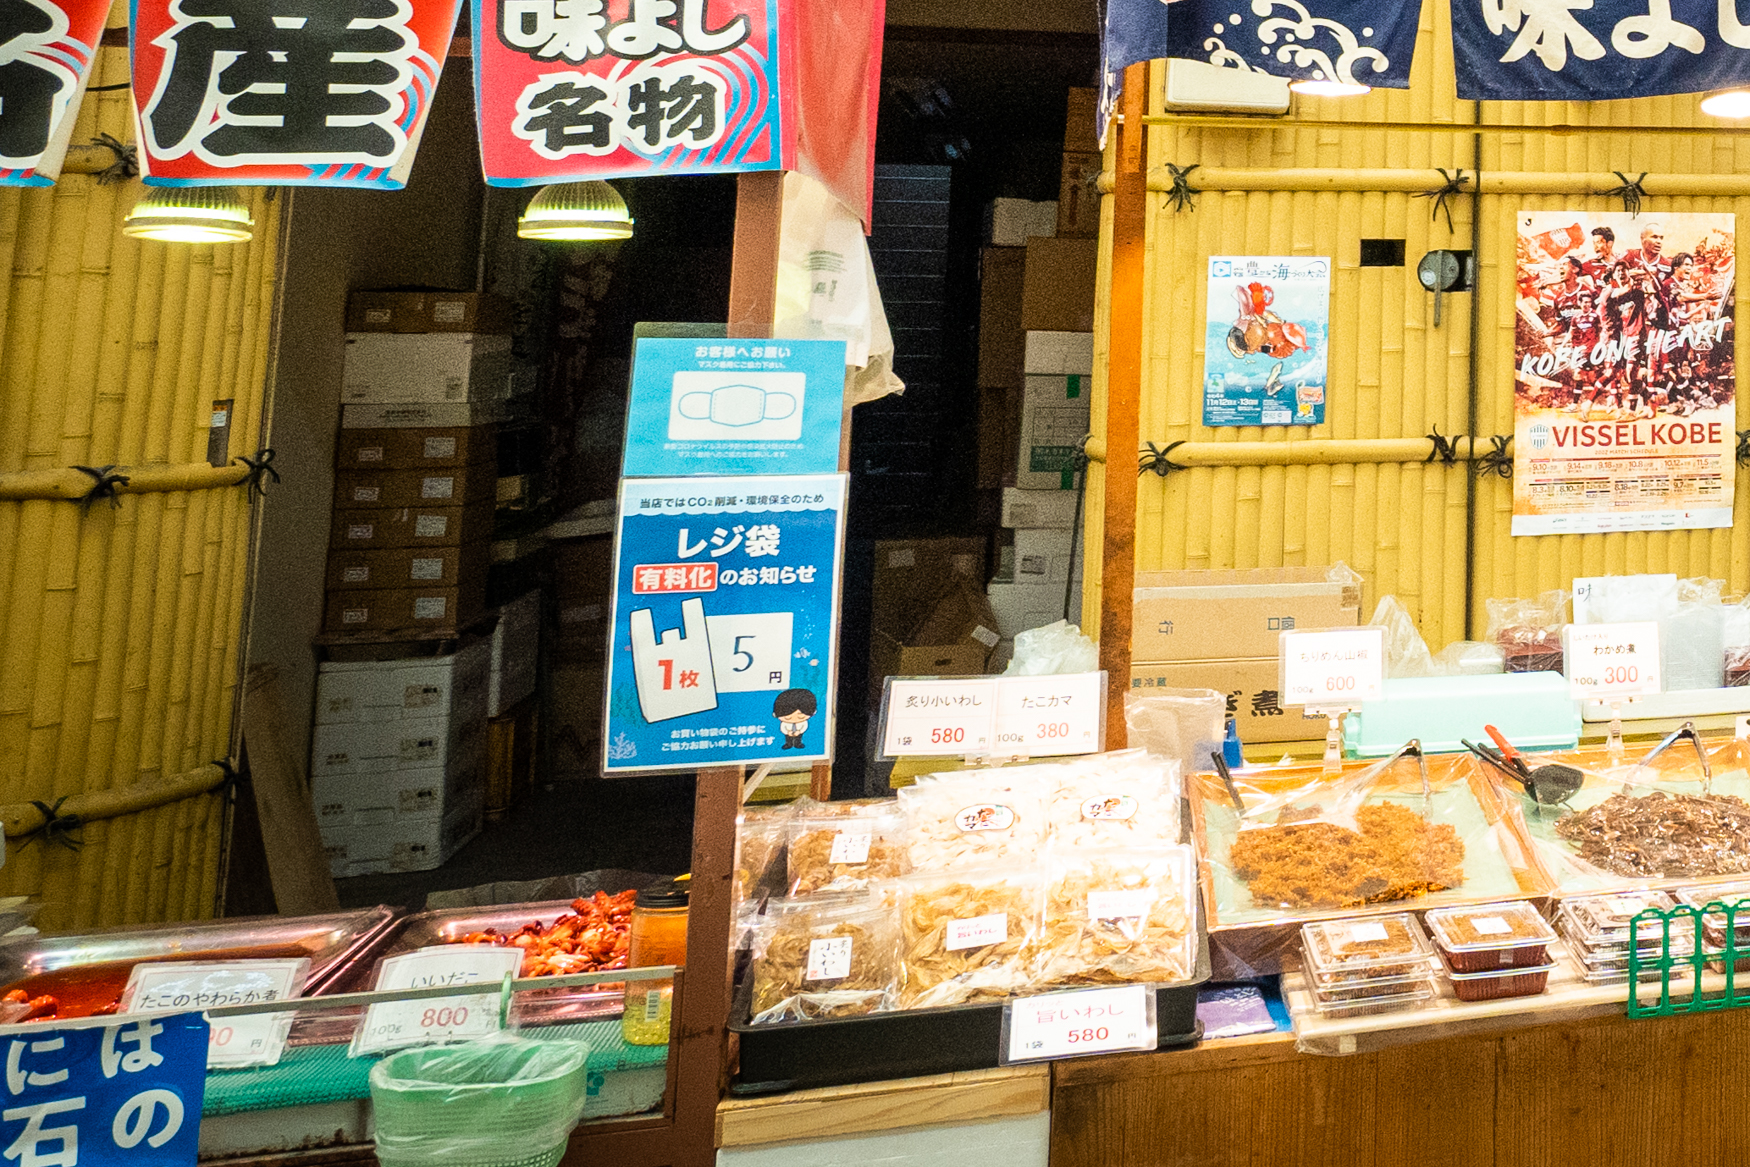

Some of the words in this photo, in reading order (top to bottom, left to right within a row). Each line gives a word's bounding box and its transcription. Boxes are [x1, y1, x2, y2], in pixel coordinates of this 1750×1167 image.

[520, 70, 725, 156] 名物
[695, 345, 791, 359] お客様へお願い
[1520, 345, 1588, 381] KOBE
[1590, 332, 1641, 366] ONE
[1645, 318, 1733, 361] HEART
[1552, 424, 1646, 448] VISSEL
[1651, 422, 1723, 445] KOBE
[677, 524, 781, 559] レジ袋
[731, 635, 757, 673] 5
[1299, 649, 1369, 663] ちりめん山椒
[1593, 643, 1637, 656] わかめ煮
[769, 671, 783, 685] 円
[1132, 677, 1167, 689] 要冷蔵
[1326, 676, 1356, 692] 600
[1604, 665, 1639, 685] 300
[905, 694, 983, 708] 炙り小いわし
[1021, 695, 1073, 709] たこカマ
[931, 727, 965, 744] 580
[997, 732, 1025, 743] 100g
[1036, 722, 1070, 739] 380
[420, 1006, 469, 1028] 800
[1036, 1003, 1125, 1025] 旨いわし
[250, 1038, 263, 1048] 円
[1068, 1026, 1110, 1044] 580
